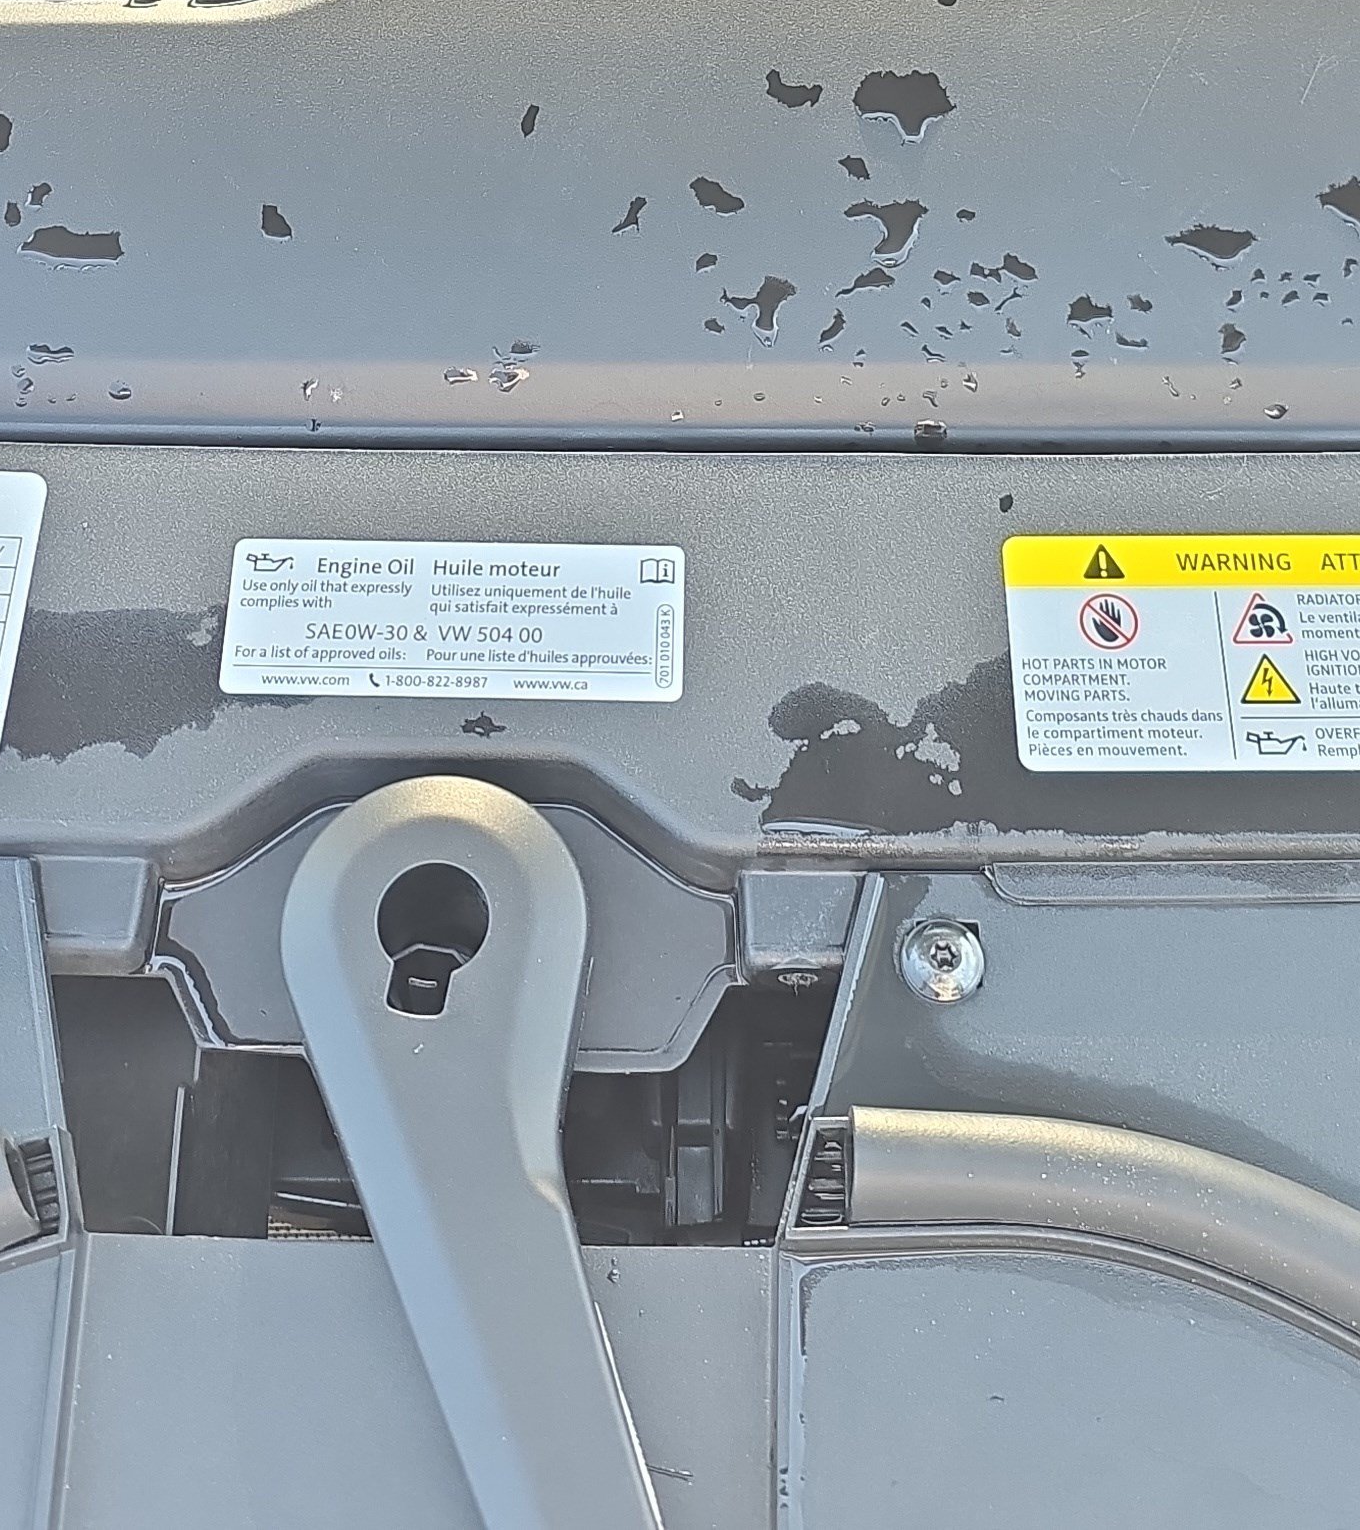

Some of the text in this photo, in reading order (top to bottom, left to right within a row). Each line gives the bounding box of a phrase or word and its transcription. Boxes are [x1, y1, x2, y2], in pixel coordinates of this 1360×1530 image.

[317, 557, 414, 579] Engine Oil
[433, 559, 561, 578] Huile moteur
[1175, 553, 1292, 572] WARNING
[242, 578, 413, 598] Use only oil that expressly
[431, 583, 632, 601] Utilisez uniquement de l'huile
[239, 594, 332, 612] complies with
[429, 599, 618, 618] qui satisfait expressément à
[1298, 611, 1316, 624] Le
[305, 622, 543, 644] SAE0W-30 & VW 504 00
[234, 644, 407, 663] For a list of approved oils:
[426, 648, 653, 668] Pour une liste d'huiles approuvées:
[1304, 649, 1339, 662] HIGH
[1022, 657, 1167, 670] HOT PARTS IN MOTOR
[261, 675, 350, 686] www.vw.com
[385, 674, 488, 689] 1-800-822-8987
[513, 679, 588, 691] www.vw.ca
[1023, 673, 1131, 686] COMPARTMENT.
[1024, 689, 1131, 702] MOVING PARTS.
[1308, 682, 1352, 695] Haute
[1026, 708, 1224, 726] Composants très chauds dans
[1027, 725, 1203, 742] le compartiment moteur.
[1028, 743, 1188, 756] Pièces en mouvement.
